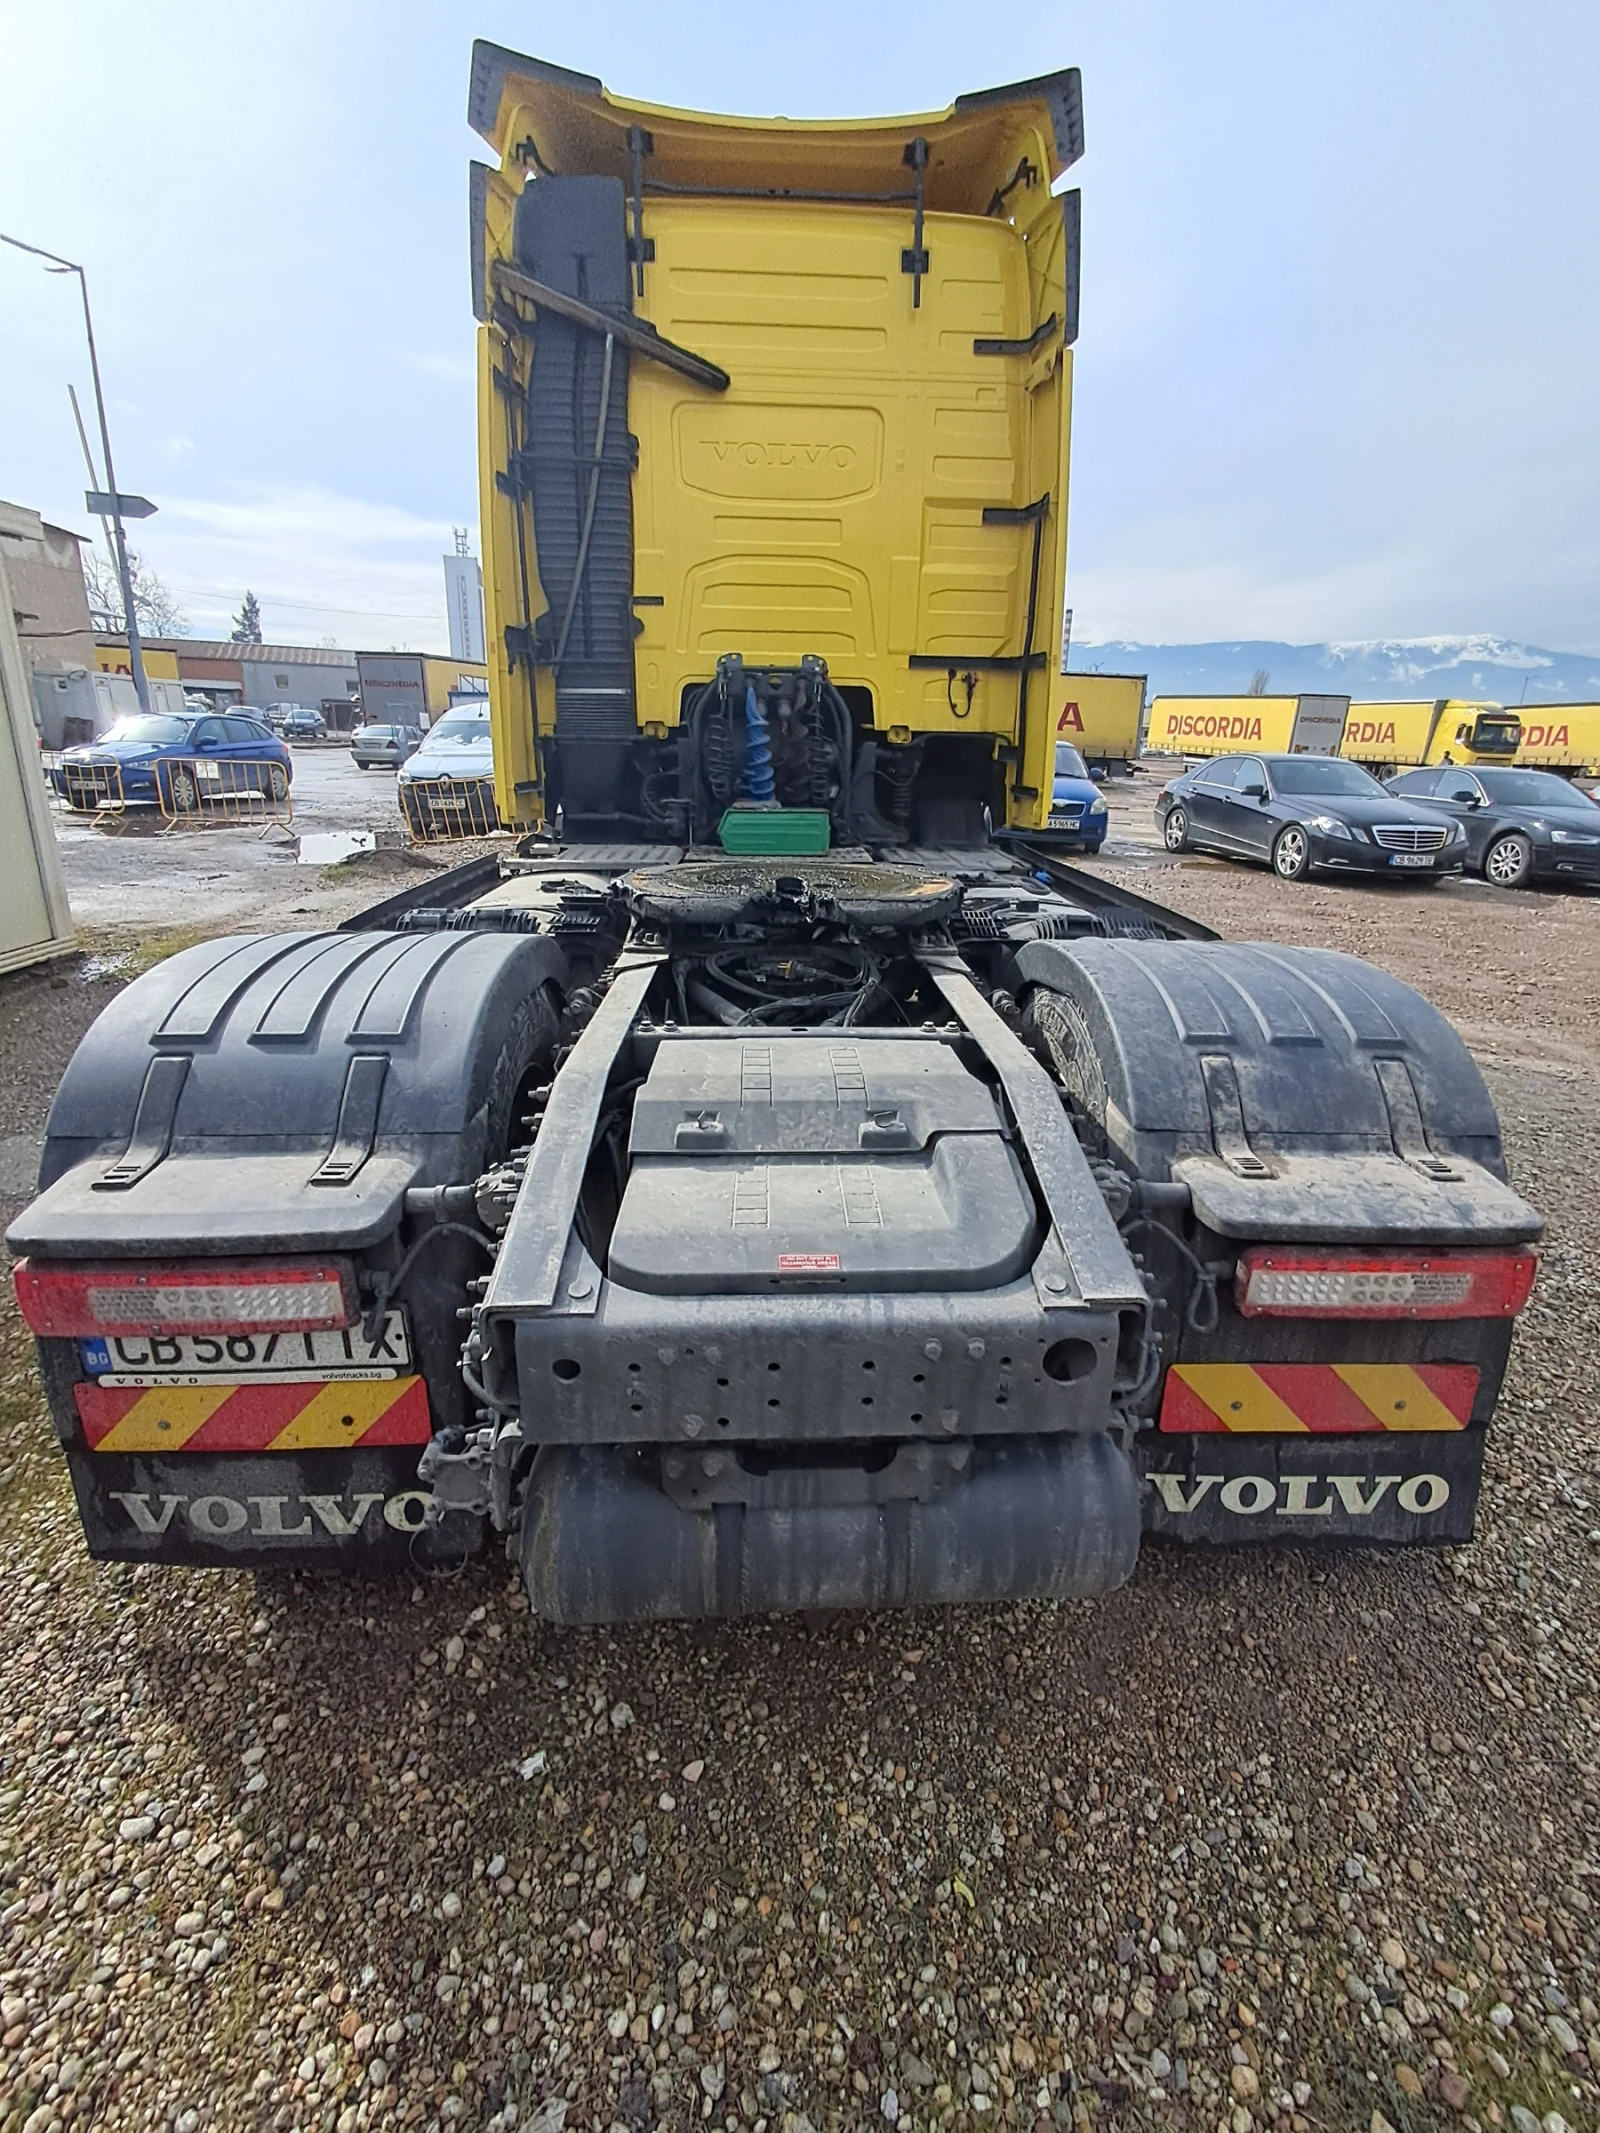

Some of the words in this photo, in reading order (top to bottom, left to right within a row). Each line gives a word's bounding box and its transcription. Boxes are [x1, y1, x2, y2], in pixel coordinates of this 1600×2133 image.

[698, 440, 857, 469] VOLVO
[1167, 715, 1262, 741] DISCORDIA
[1300, 716, 1342, 725] DISCORDIA
[87, 1352, 109, 1365] BG
[115, 1377, 199, 1386] VOLVO
[320, 1371, 382, 1380] volvotrucks.bg
[1145, 1473, 1450, 1515] VOLVO
[109, 1490, 445, 1535] VOLVO
